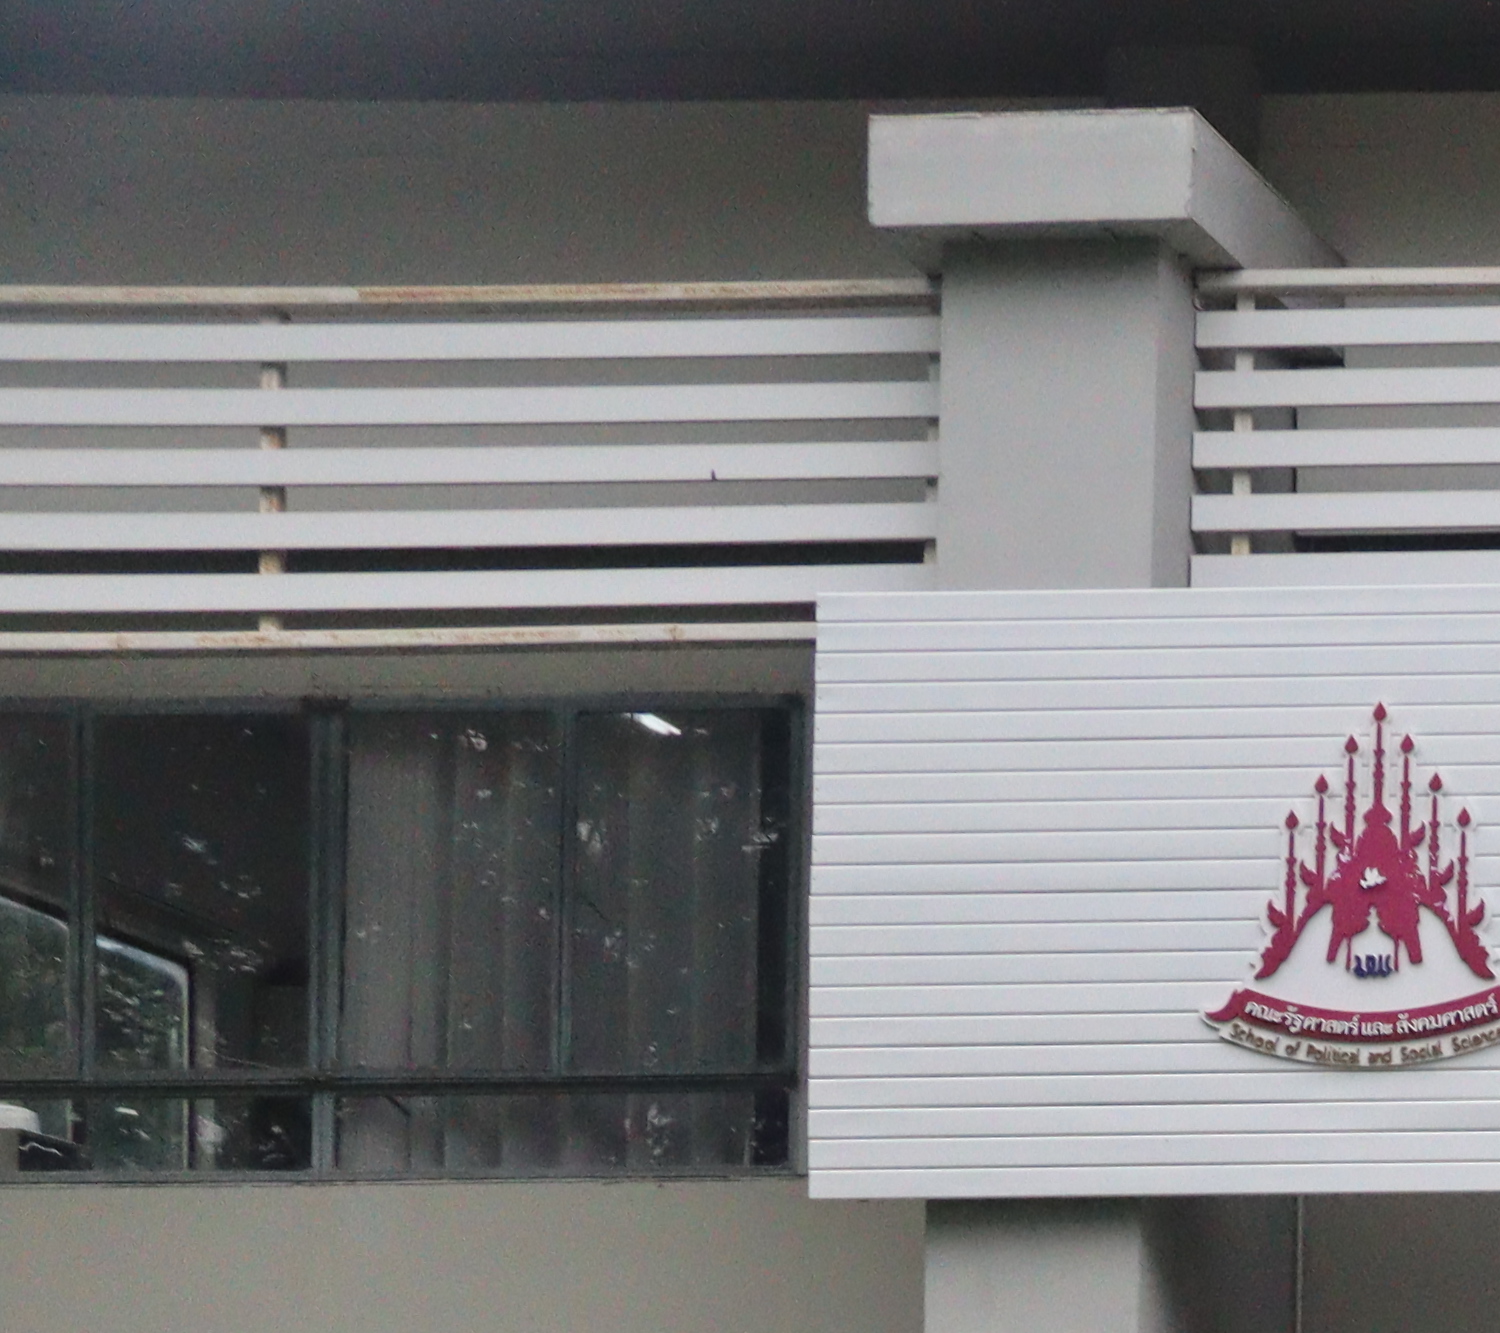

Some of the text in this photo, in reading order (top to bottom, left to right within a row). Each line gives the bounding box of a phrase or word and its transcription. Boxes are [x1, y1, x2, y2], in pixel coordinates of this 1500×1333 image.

[1229, 1022, 1280, 1053] School
[1285, 1040, 1302, 1057] of
[1306, 1043, 1360, 1063] Political
[1367, 1047, 1393, 1065] and
[1400, 1040, 1444, 1062] Social
